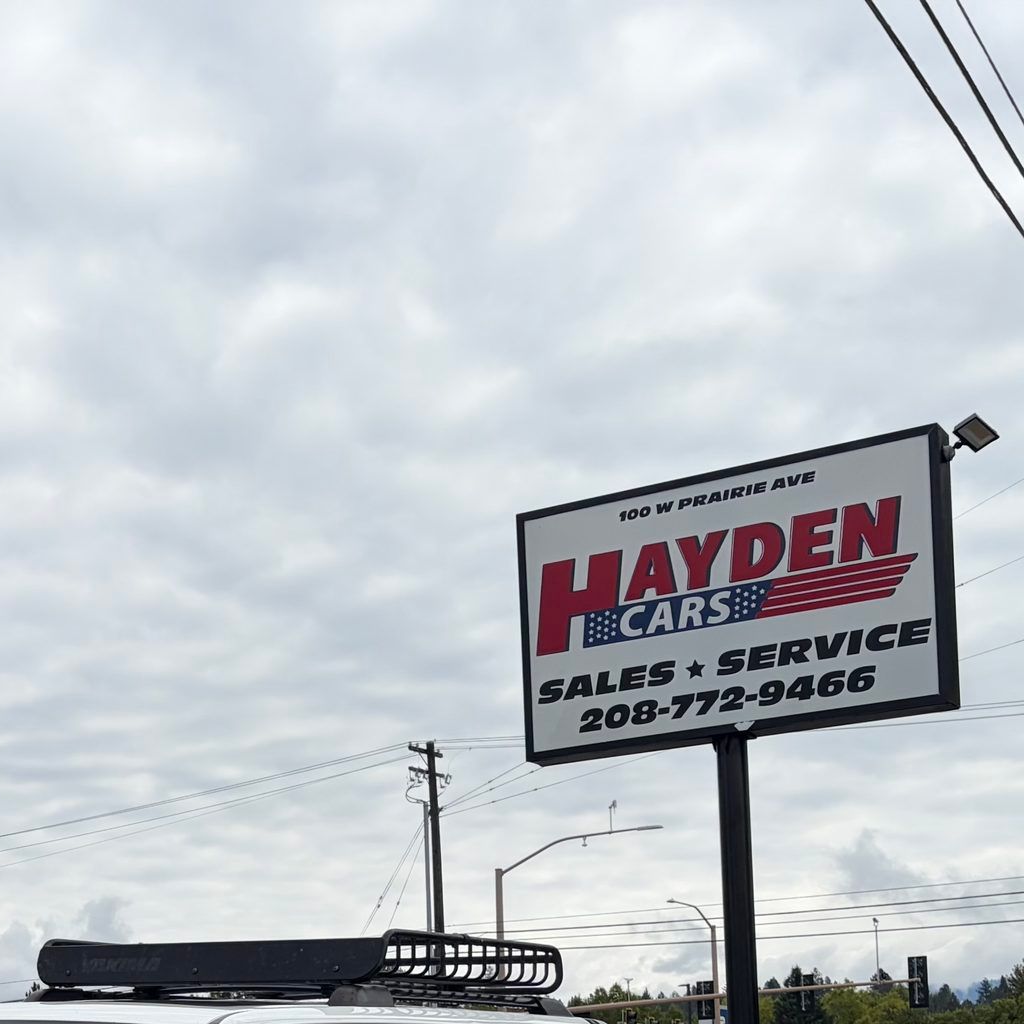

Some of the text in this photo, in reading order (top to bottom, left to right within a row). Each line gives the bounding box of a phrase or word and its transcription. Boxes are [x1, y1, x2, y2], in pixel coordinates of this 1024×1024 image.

[619, 471, 816, 522] 100 W PRAIRIE AVE
[536, 495, 903, 657] HAYDEN
[619, 590, 733, 638] CARS
[537, 618, 933, 705] SALES SERVICE
[579, 665, 877, 733] 208-772-9466
